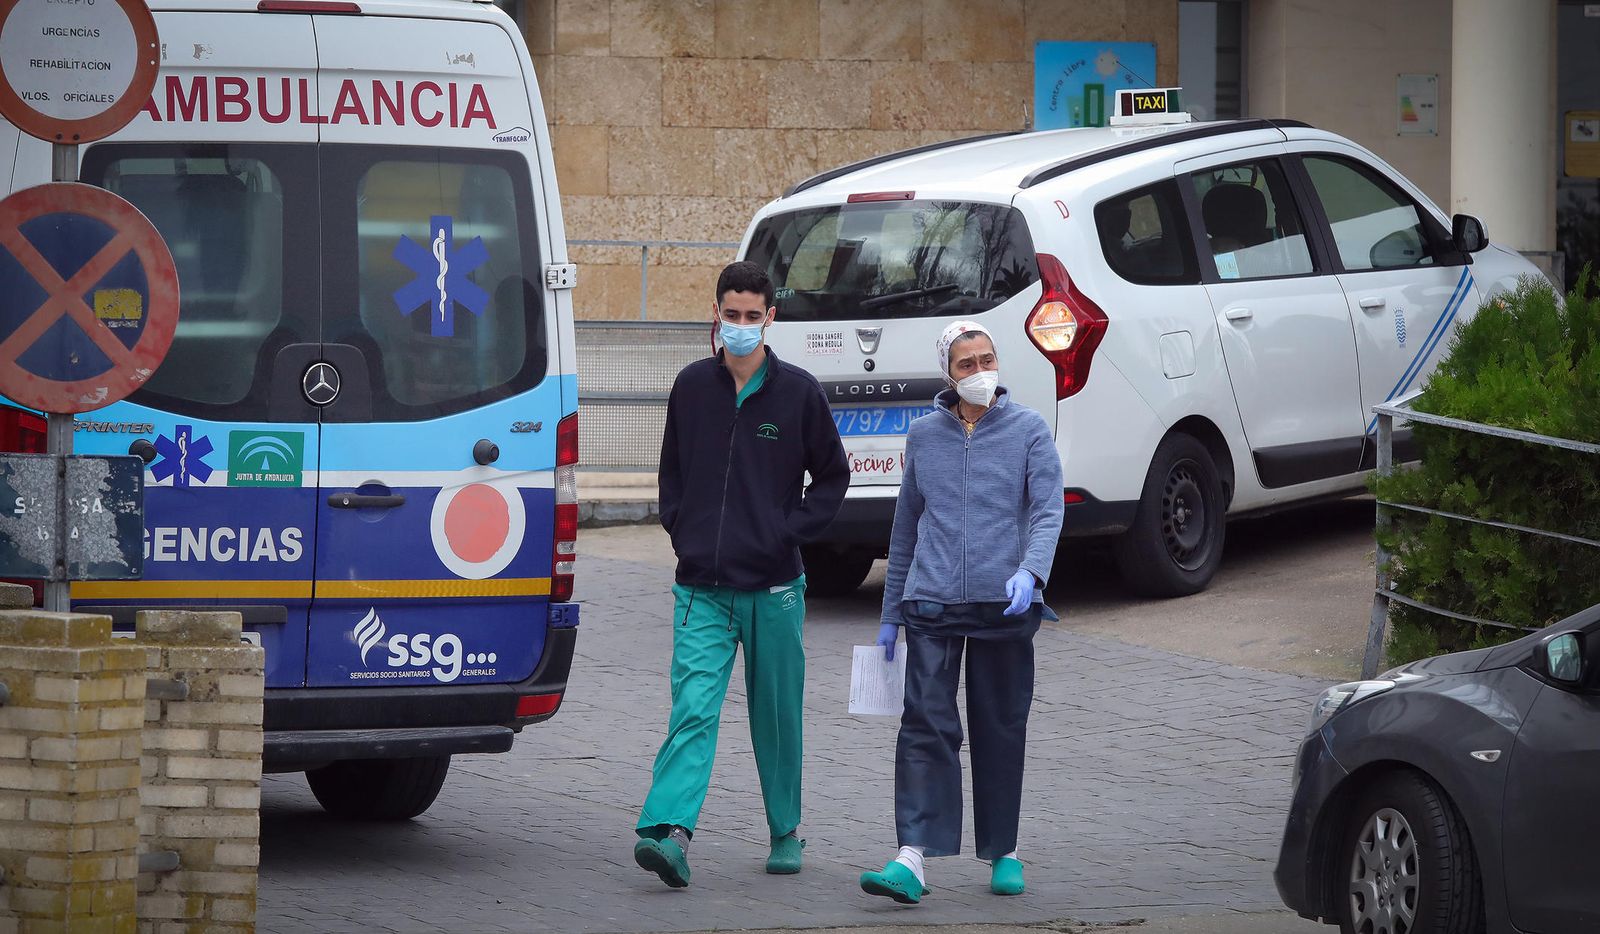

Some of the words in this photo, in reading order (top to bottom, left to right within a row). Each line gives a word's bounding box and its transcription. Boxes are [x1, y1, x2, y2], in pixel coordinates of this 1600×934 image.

[42, 26, 100, 38] URGENCIAS
[30, 58, 111, 71] REHABILITACION
[21, 91, 50, 101] VLOS.
[63, 91, 115, 103] OFICIALES
[1136, 95, 1165, 110] TAXI
[835, 383, 907, 395] LODGY
[510, 421, 543, 433] 324
[832, 409, 886, 433] 7797
[235, 473, 253, 481] JUNTA
[255, 473, 263, 481] DE
[264, 473, 295, 482] ANDALUCIA
[143, 527, 303, 563] ENCIAS
[350, 672, 379, 680] SERVICIOS
[380, 671, 398, 679] SOCIO
[398, 670, 431, 678] SANITARIOS
[462, 668, 496, 677] GENERALES
